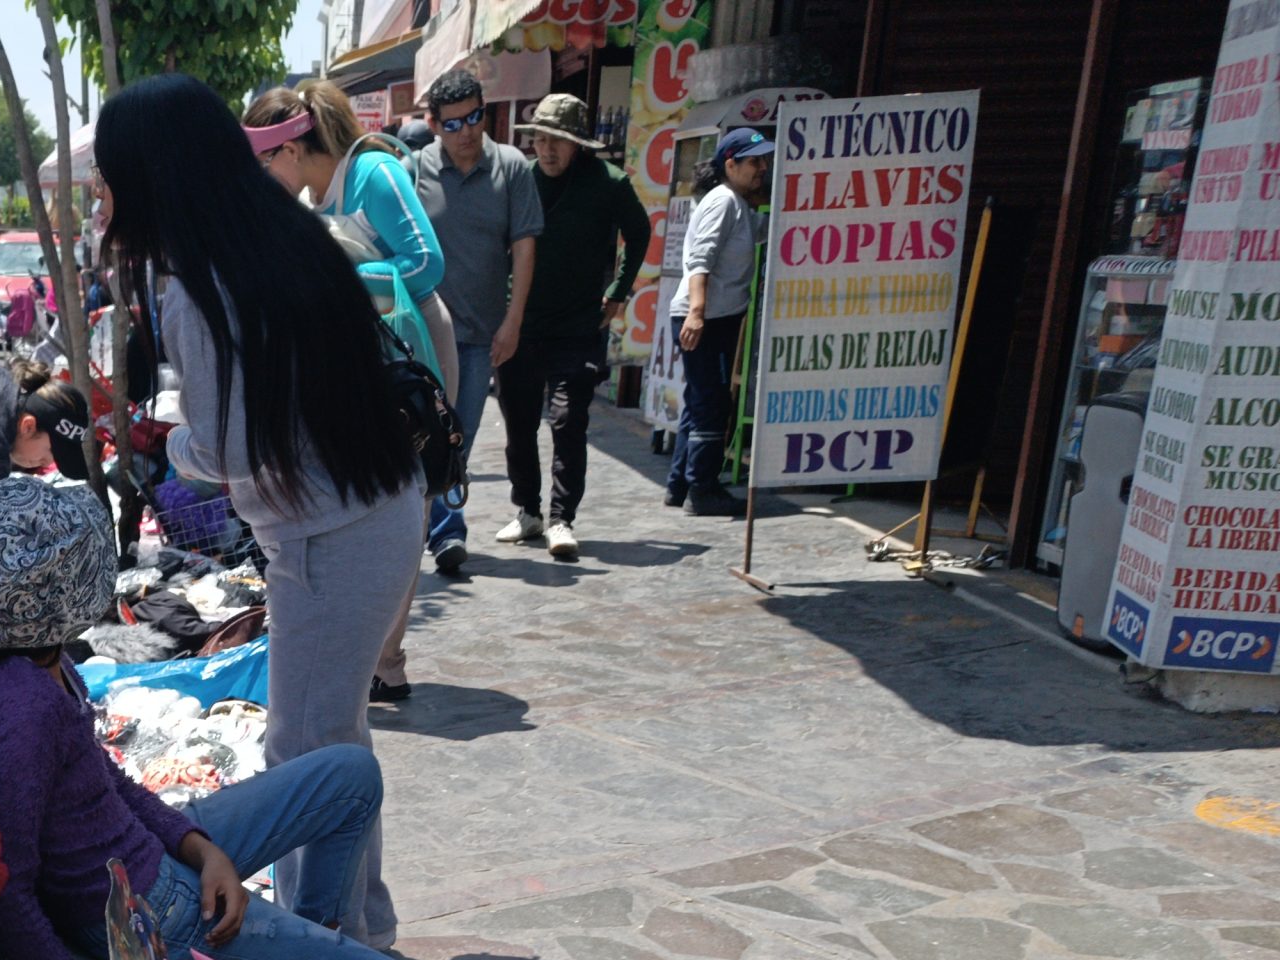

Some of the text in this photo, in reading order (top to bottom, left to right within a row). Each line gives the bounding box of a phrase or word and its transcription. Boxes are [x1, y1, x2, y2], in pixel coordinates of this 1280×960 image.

[786, 102, 970, 160] S.TÉCNICO
[781, 164, 965, 212] LLAVES
[780, 218, 957, 266] COPIAS
[773, 272, 953, 320] FIBRA DE VIDRIO
[1170, 289, 1220, 320] MOUSE
[769, 328, 948, 373] PILAS DE RELOJ
[765, 384, 941, 424] BEBIDAS HELADAS
[1152, 386, 1198, 424] ALCOHOL
[781, 429, 914, 474] BCP
[1200, 445, 1234, 468] SE
[1187, 527, 1213, 549] LA
[1117, 564, 1158, 603] HELADAS
[1120, 543, 1164, 584] BEBIDAS
[1117, 607, 1140, 641] BCP
[1188, 629, 1255, 661] BCP
